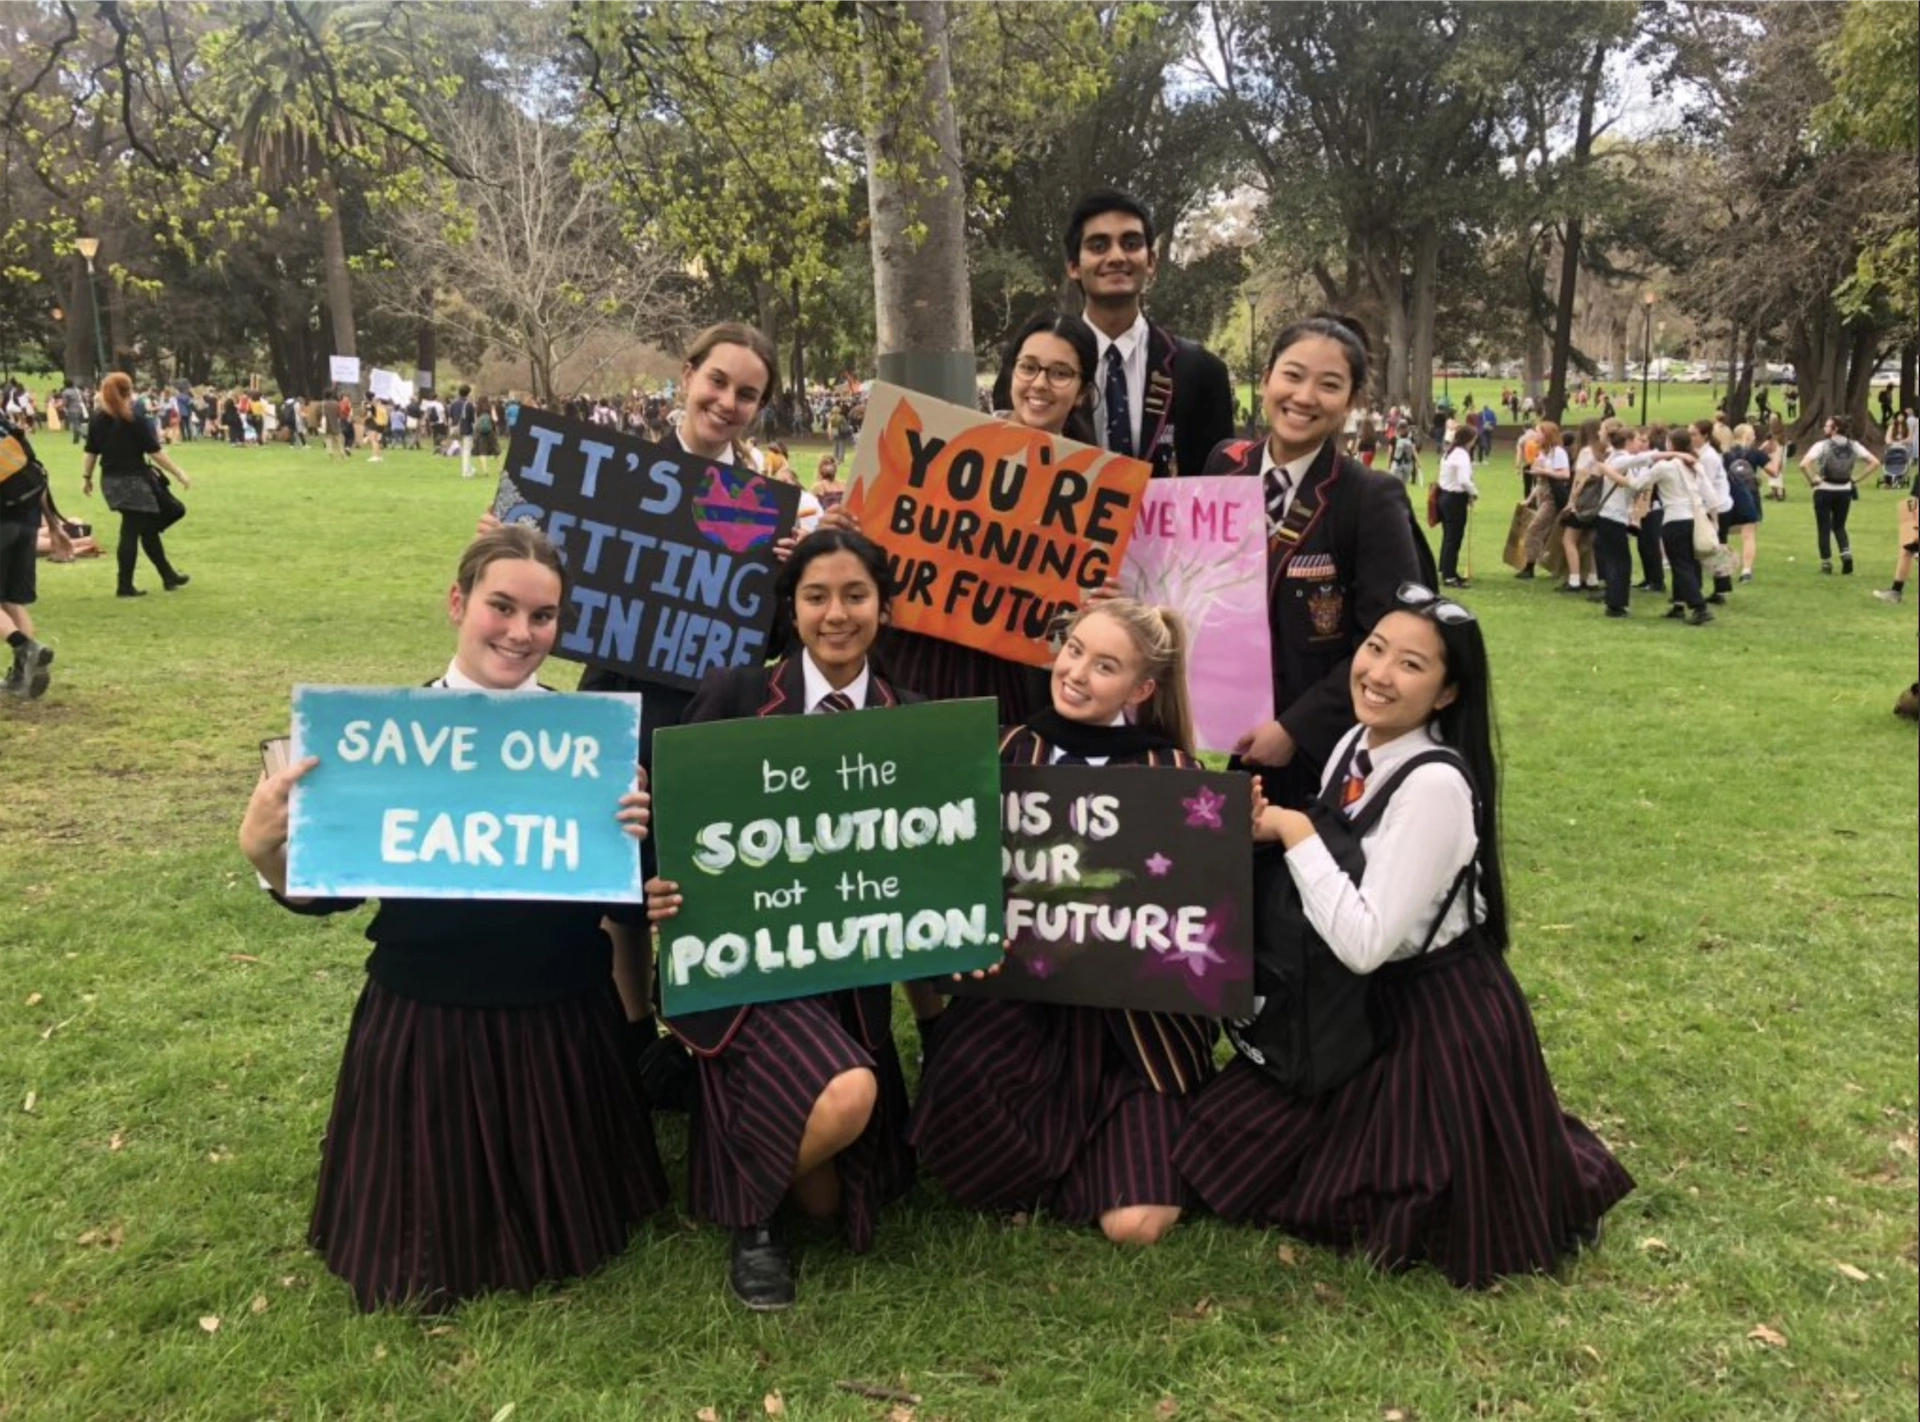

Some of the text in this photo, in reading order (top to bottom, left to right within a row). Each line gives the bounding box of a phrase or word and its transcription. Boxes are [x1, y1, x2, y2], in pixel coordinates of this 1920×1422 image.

[520, 425, 683, 515] IT'S
[906, 429, 1131, 546] YOU'RE
[890, 495, 1112, 589] BURNING
[1132, 496, 1241, 542] VE ME
[561, 585, 645, 663] IN
[884, 554, 1078, 646] UR FUTUR
[337, 718, 599, 778] SAVE OUR
[762, 753, 897, 793] be the
[380, 807, 580, 871] EARTH
[692, 797, 977, 875] SOLUTION
[1001, 791, 1121, 838] IS IS
[754, 870, 900, 910] not the
[1006, 898, 1208, 952] FUTURE
[668, 904, 1000, 986] POLLUTION.
